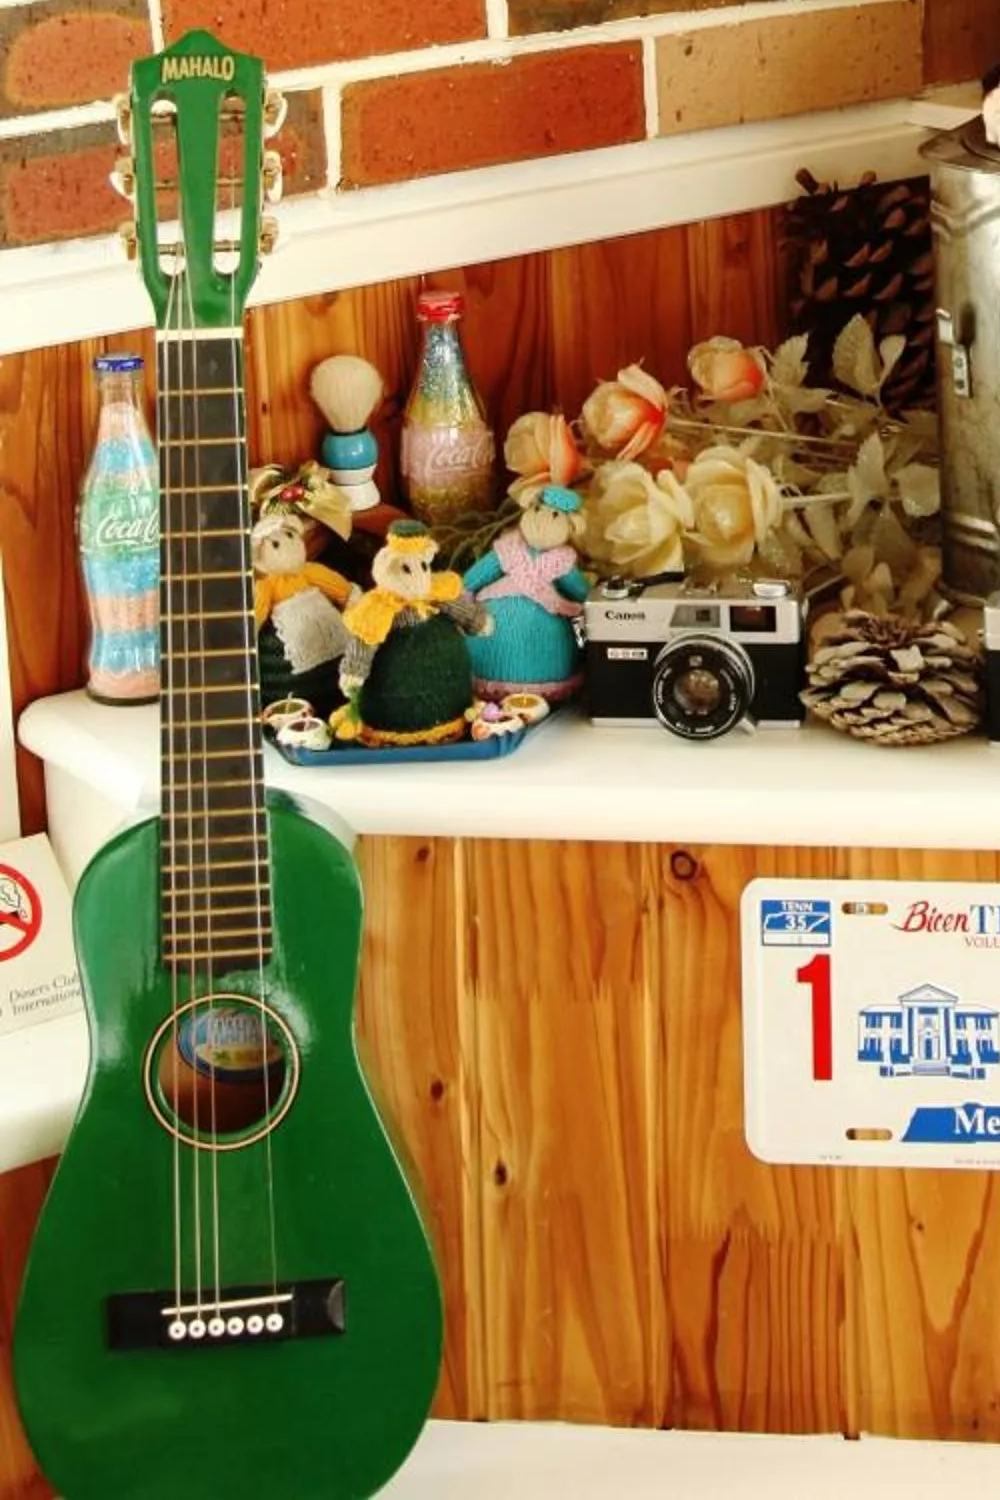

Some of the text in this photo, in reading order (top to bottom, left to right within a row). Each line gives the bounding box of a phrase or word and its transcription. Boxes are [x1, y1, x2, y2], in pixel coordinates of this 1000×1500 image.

[161, 55, 236, 83] MAHALO
[604, 610, 646, 621] Canon
[796, 954, 833, 1081] 1
